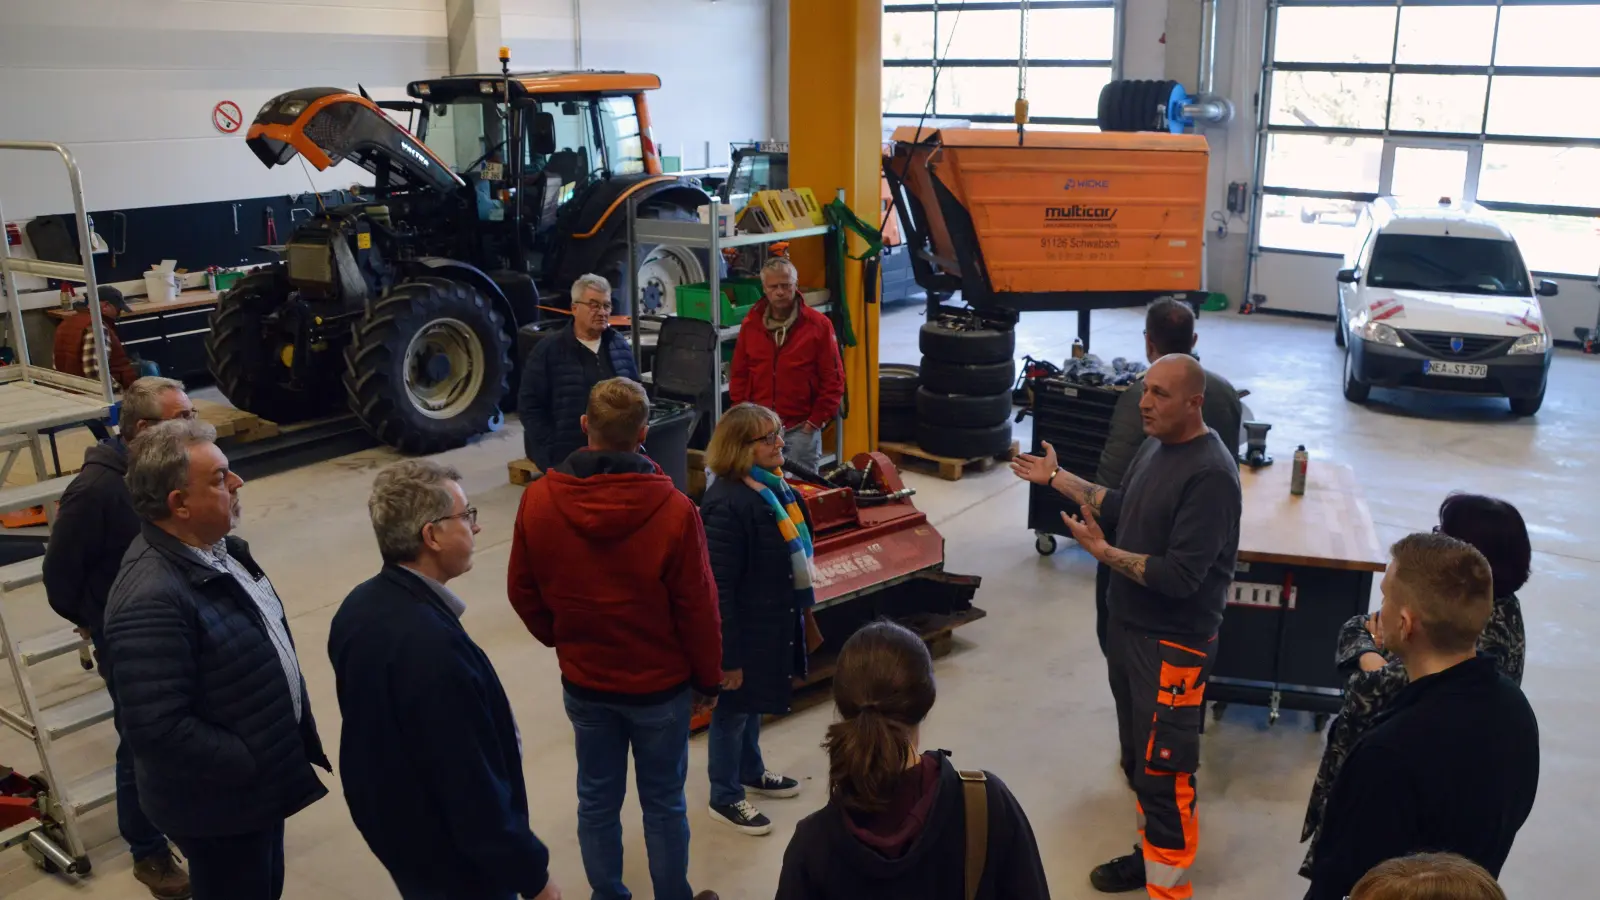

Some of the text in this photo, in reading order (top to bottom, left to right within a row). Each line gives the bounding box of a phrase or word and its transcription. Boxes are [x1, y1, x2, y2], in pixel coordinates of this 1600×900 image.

[1077, 179, 1109, 188] WICKE
[1040, 237, 1120, 249] 91126 Schwabach
[1429, 362, 1487, 376] NEA ST 370
